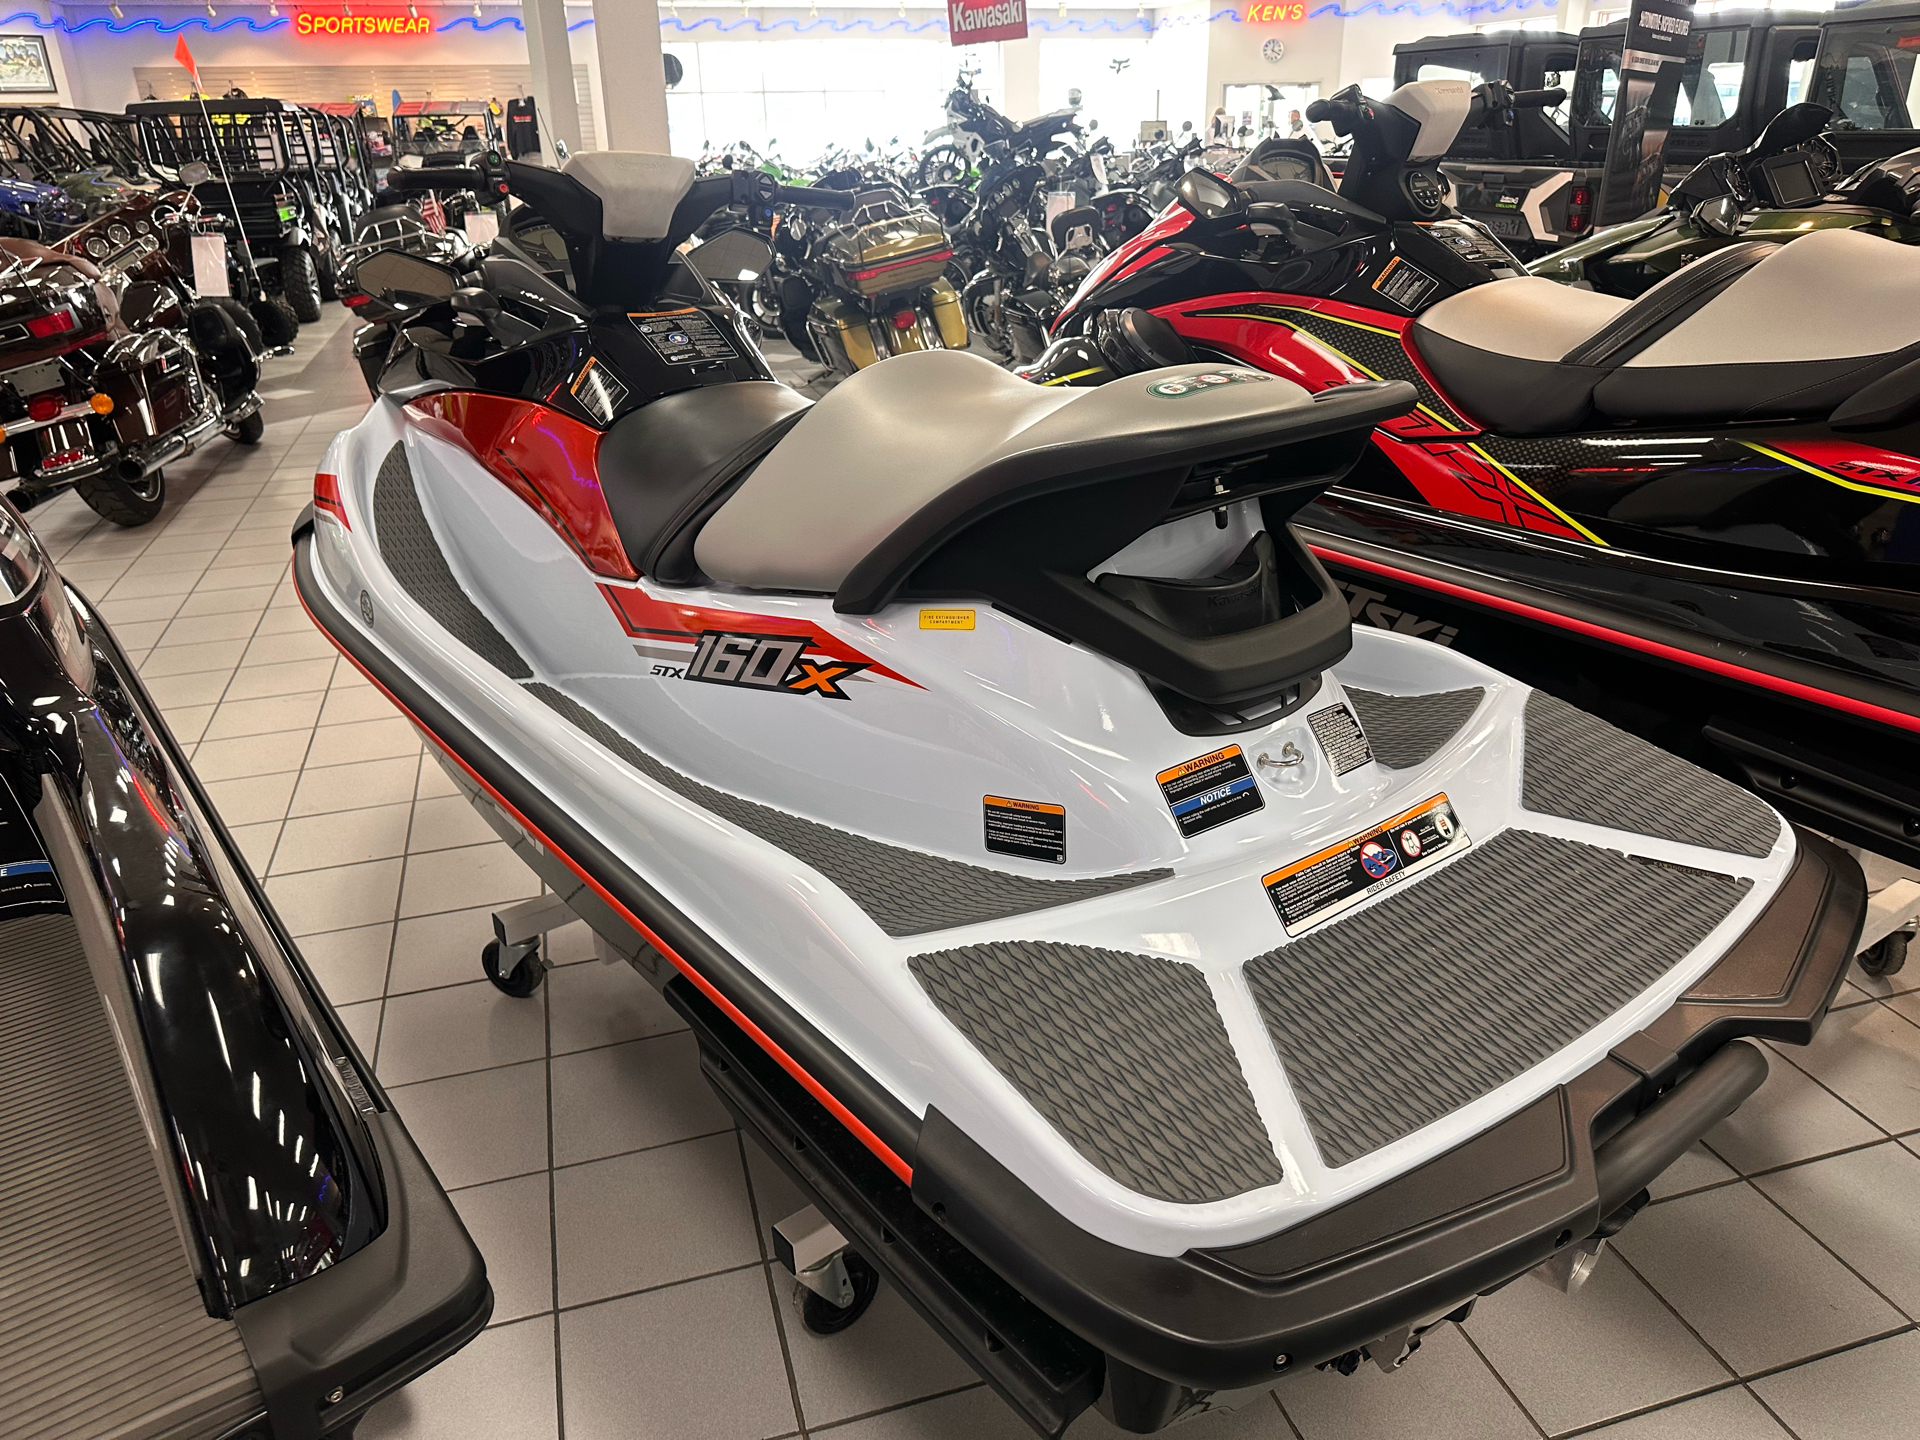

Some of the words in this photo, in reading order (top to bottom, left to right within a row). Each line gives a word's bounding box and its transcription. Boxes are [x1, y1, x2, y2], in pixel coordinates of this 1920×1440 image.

[952, 0, 1023, 32] Kawasaki
[1246, 4, 1303, 22] KEN'S
[297, 13, 430, 34] SPORTSWEAR
[1486, 219, 1521, 235] asaki
[650, 664, 686, 680] STX
[1184, 752, 1225, 772] WARNING
[1200, 787, 1231, 805] NOTICE
[1013, 802, 1039, 810] WARNING
[1353, 826, 1383, 845] WARNING
[1366, 881, 1384, 895] RIDER
[1384, 870, 1406, 887] SAFETY
